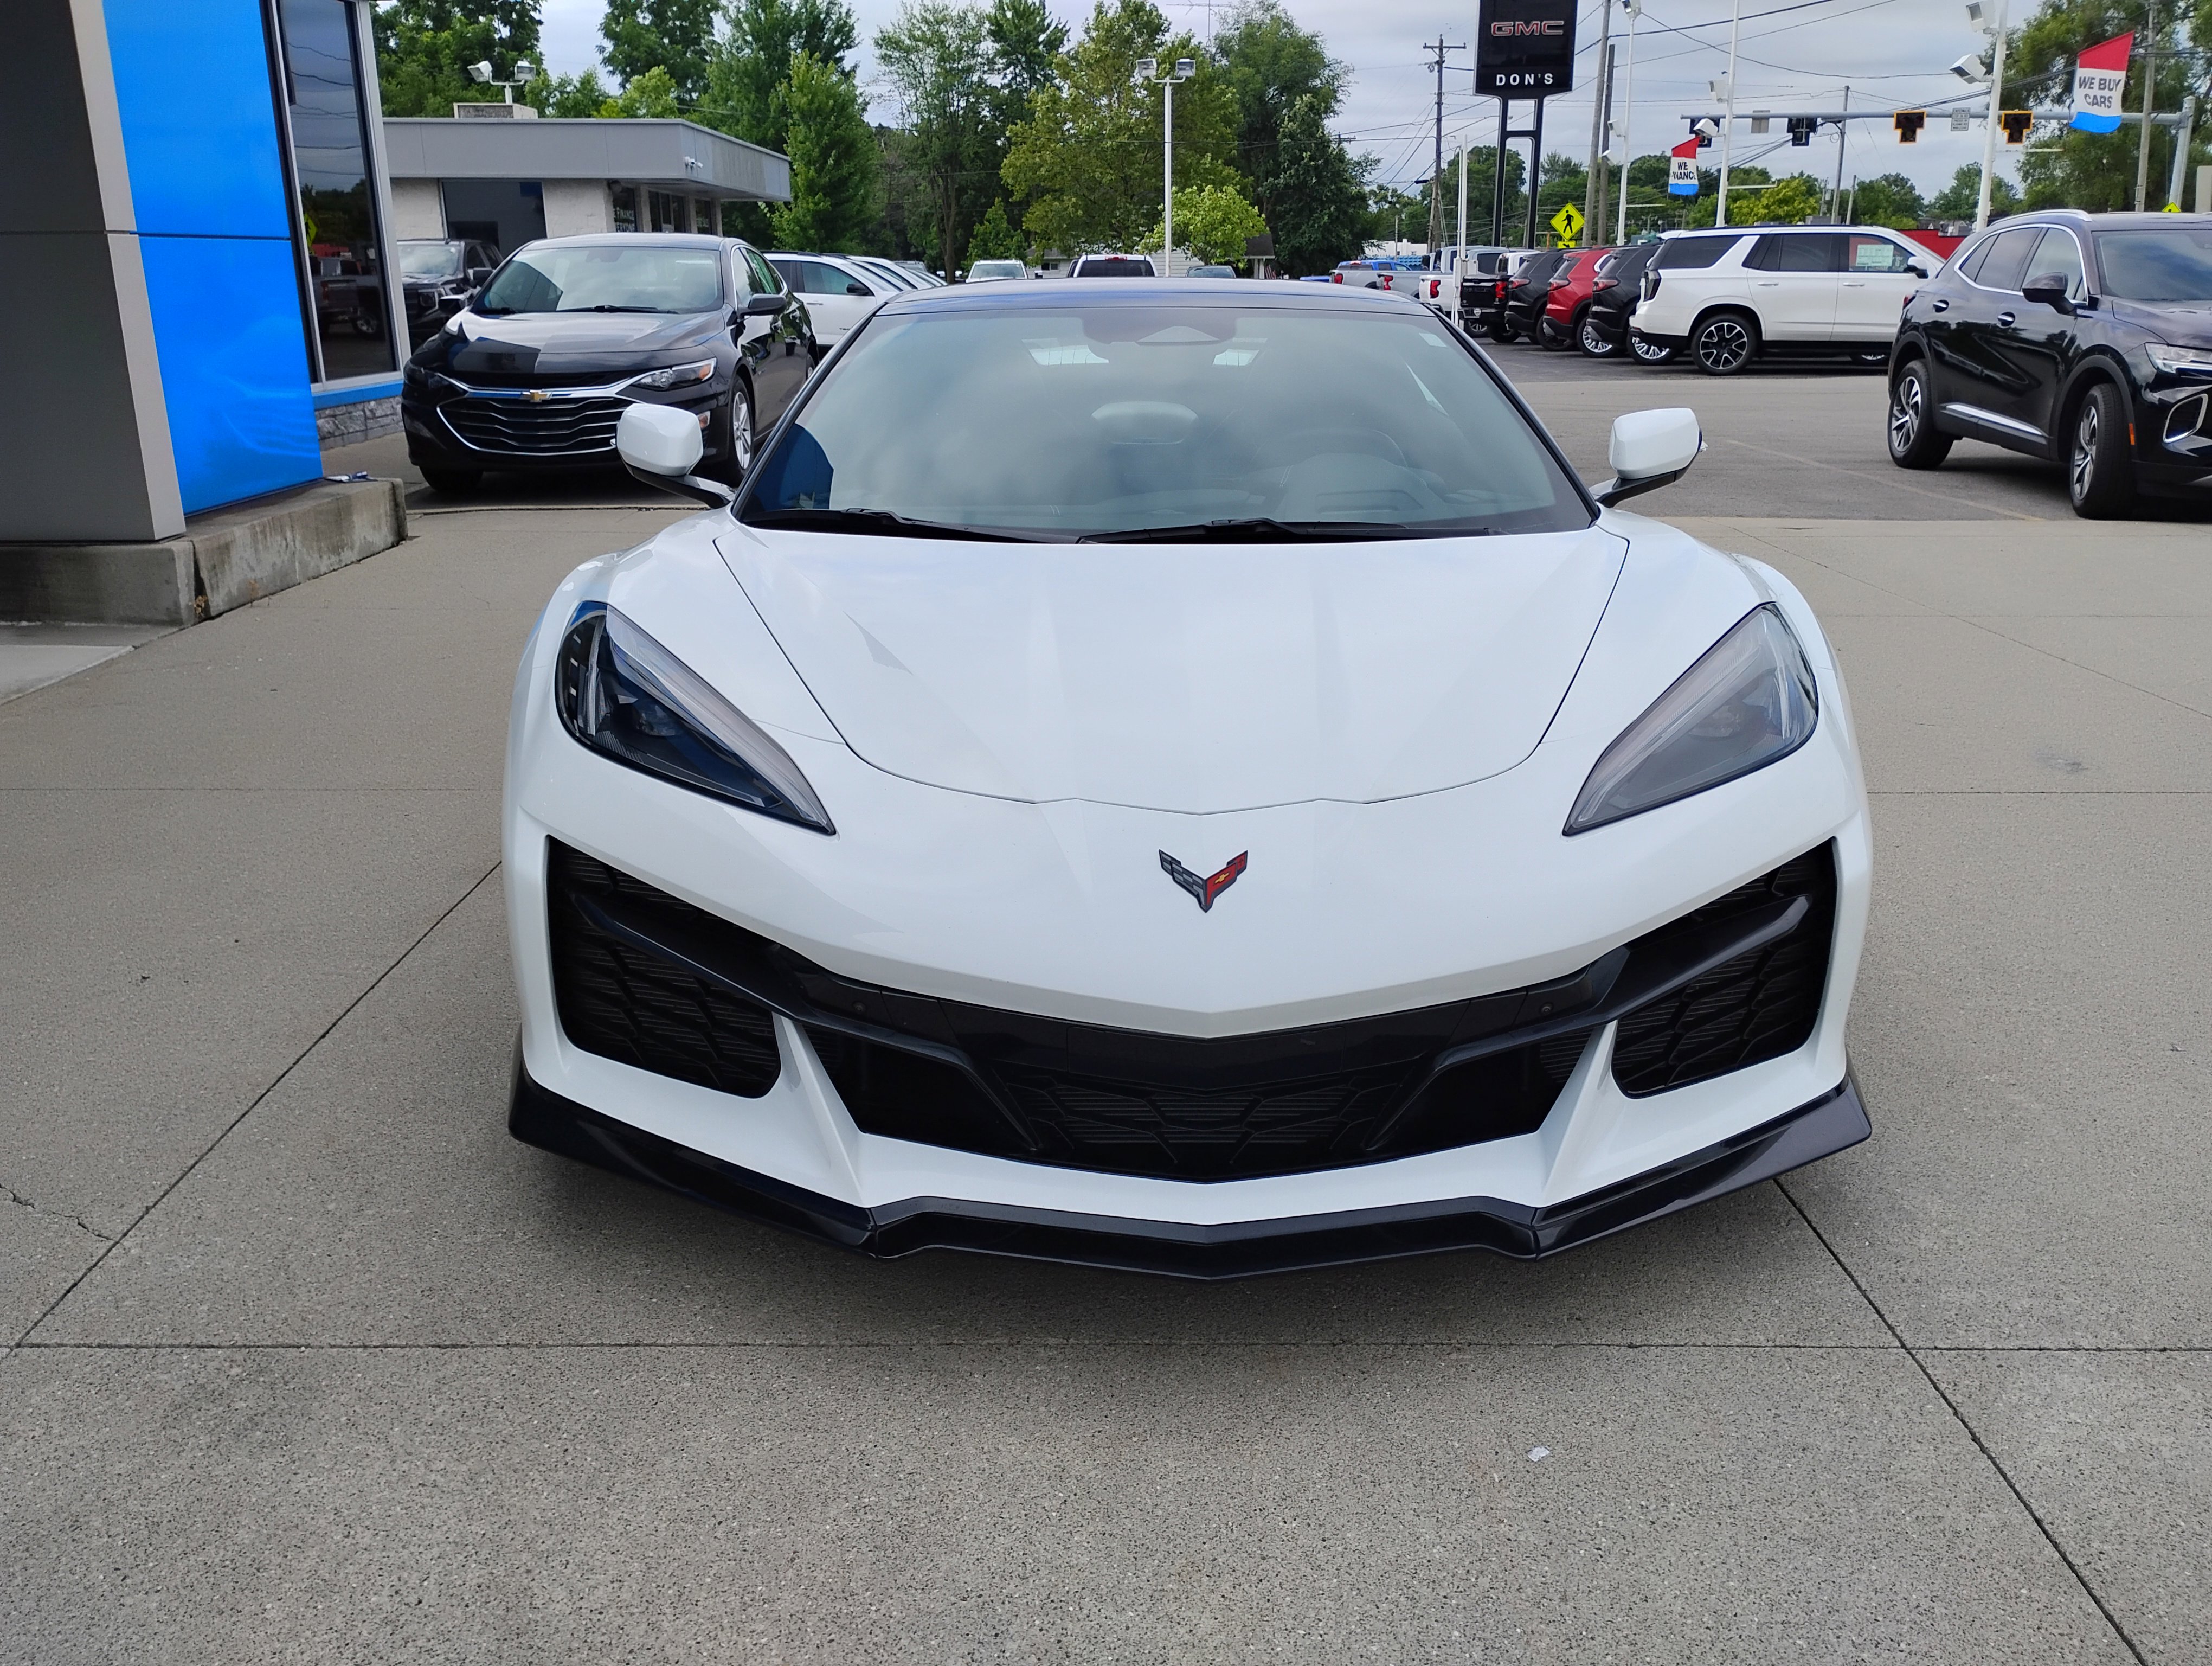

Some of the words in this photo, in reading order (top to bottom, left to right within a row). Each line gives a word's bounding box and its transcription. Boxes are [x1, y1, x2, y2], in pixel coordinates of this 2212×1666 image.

[1491, 21, 1564, 36] GMC
[1496, 73, 1553, 86] DON'S
[2079, 76, 2096, 89] WE
[2098, 78, 2123, 92] BUY
[2084, 93, 2113, 109] CARS
[1677, 162, 1688, 171] WE
